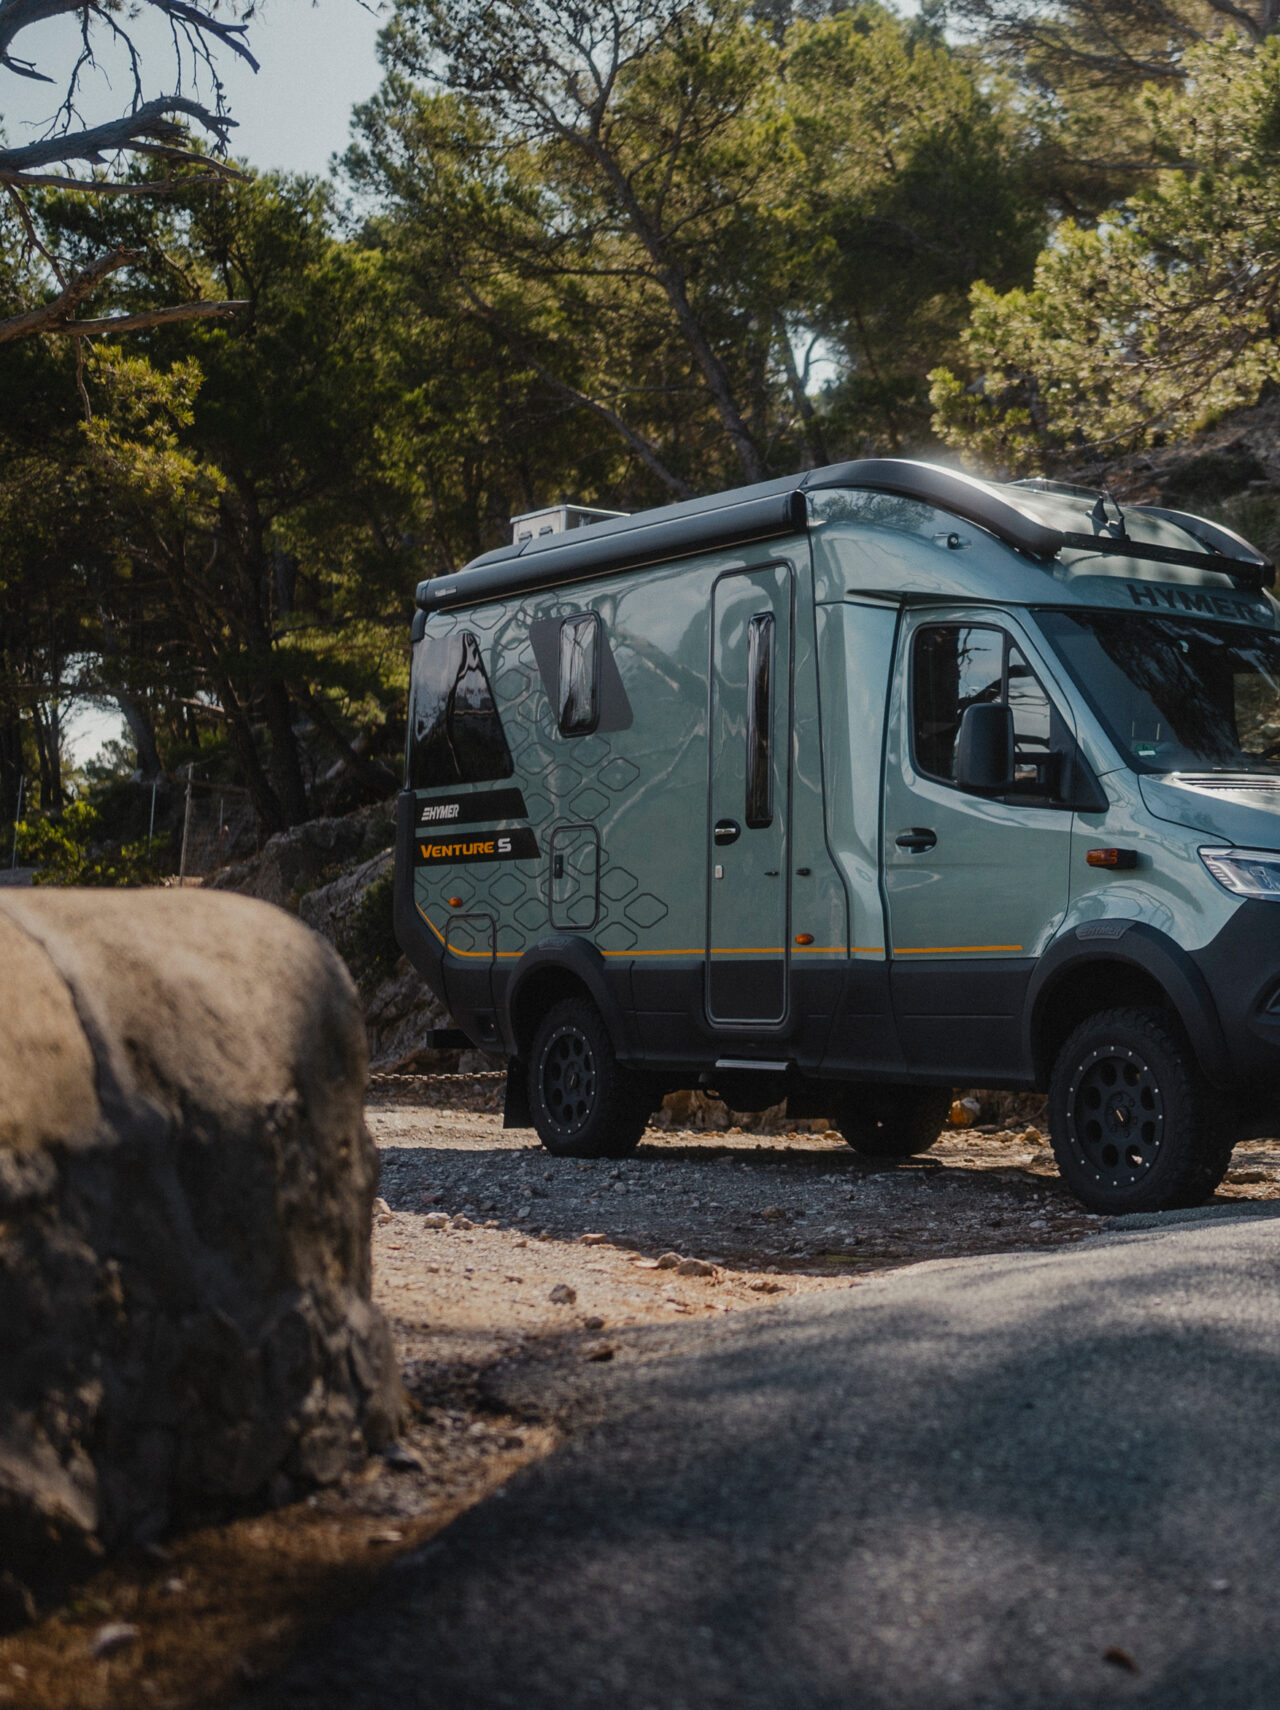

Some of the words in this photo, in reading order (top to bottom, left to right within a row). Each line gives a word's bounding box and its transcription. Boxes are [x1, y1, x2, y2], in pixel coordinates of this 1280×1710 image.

[1126, 583, 1260, 622] HYMER
[422, 804, 460, 821] HYMER
[420, 841, 495, 858] VENTURE
[498, 837, 512, 853] S
